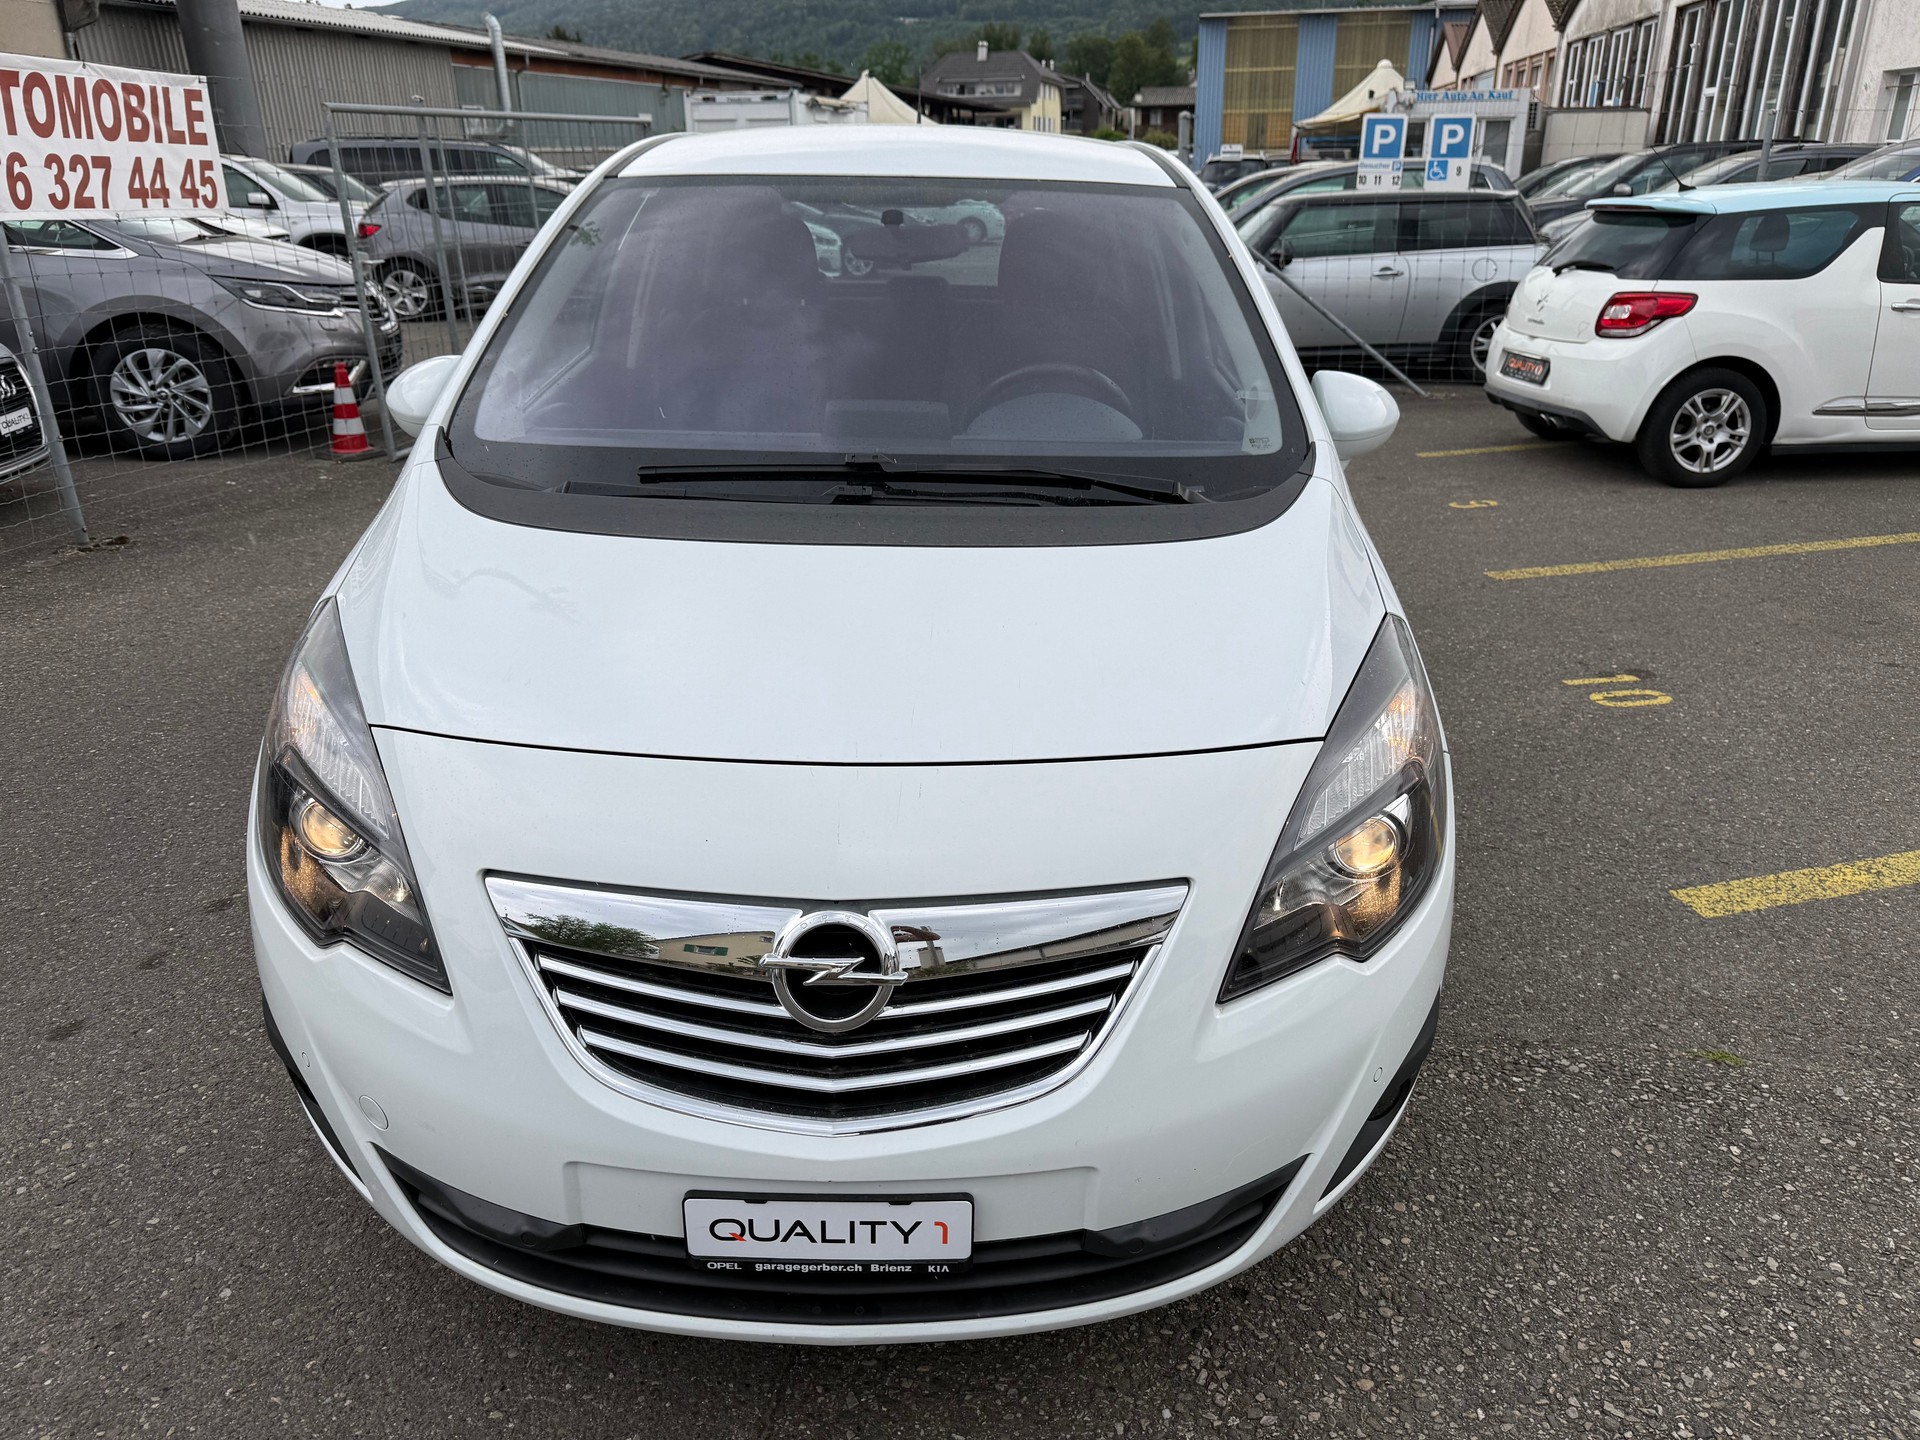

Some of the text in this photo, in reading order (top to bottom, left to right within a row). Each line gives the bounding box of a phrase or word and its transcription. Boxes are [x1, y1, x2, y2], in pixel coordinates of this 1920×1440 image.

[1416, 90, 1514, 101] Hier Auto An Kauf
[1371, 124, 1397, 155] P
[1439, 124, 1465, 155] P
[1358, 174, 1401, 186] 10 11 12
[1455, 166, 1462, 176] 9
[0, 151, 218, 211] 6 327 44 45
[708, 1218, 949, 1245] QUALITY 1
[706, 1261, 950, 1273] OPEL garagegerber.ch Brienz KIA
